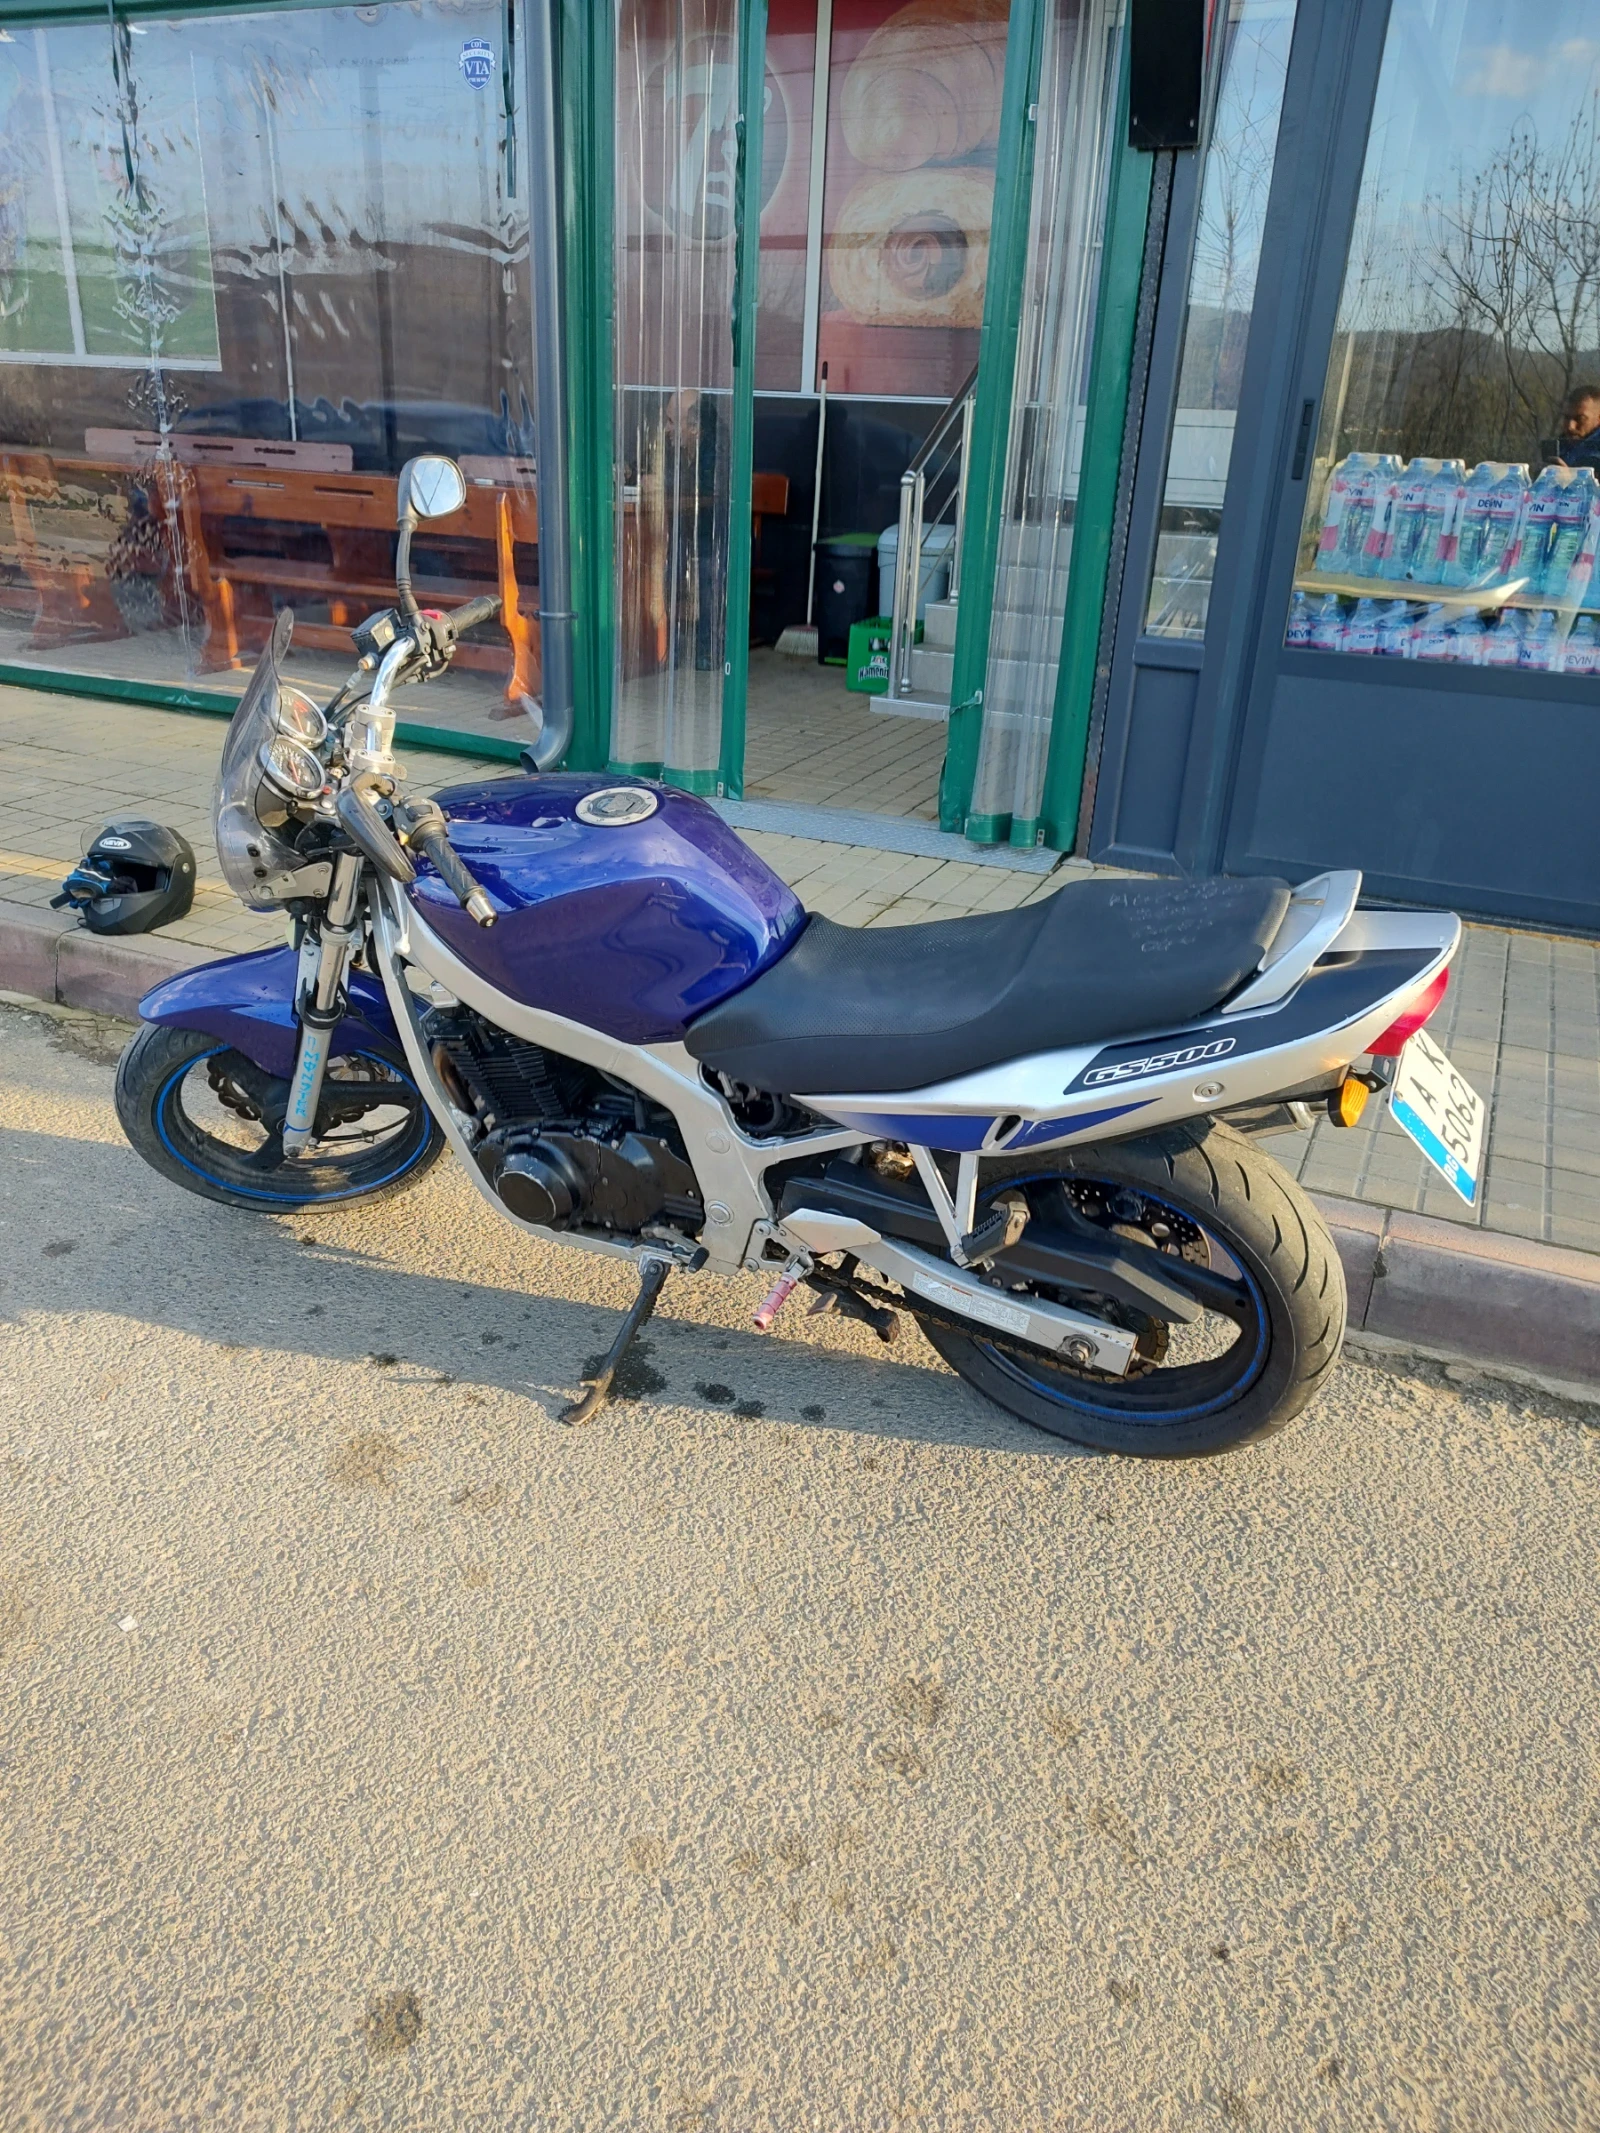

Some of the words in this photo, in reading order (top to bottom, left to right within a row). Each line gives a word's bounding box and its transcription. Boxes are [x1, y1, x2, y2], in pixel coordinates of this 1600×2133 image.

[464, 61, 489, 75] VTA
[1083, 1037, 1236, 1086] GS500
[1440, 1073, 1476, 1164] 5062
[1443, 1153, 1460, 1184] BG
